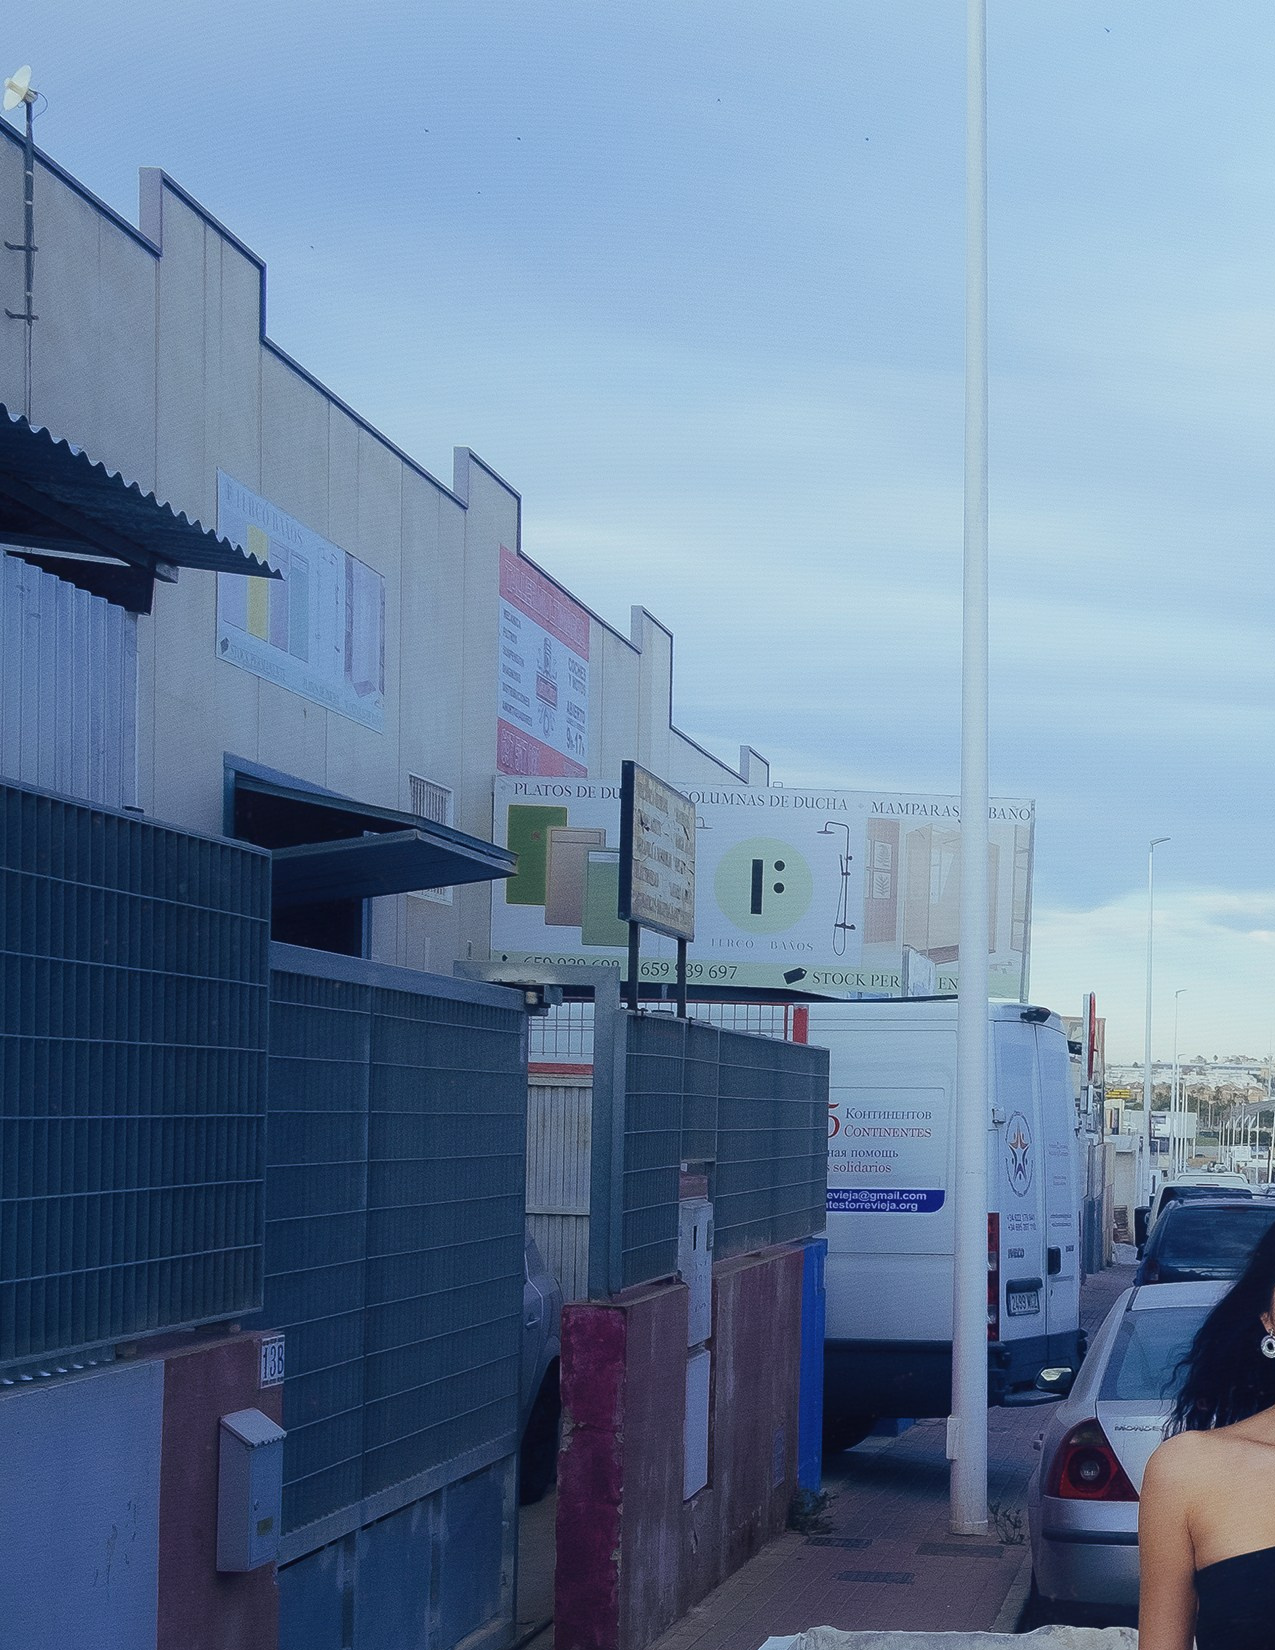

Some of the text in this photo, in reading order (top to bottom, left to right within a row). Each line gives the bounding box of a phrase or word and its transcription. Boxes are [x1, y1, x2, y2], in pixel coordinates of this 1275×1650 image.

[514, 782, 572, 798] PLATOS
[576, 785, 597, 799] DE
[769, 794, 790, 808] DE
[793, 796, 848, 812] DUCHA
[871, 800, 960, 818] MAMPARAS
[988, 804, 1031, 821] BAÑO
[640, 961, 738, 979] 659 39 697
[812, 971, 866, 987] STOCK
[850, 1149, 899, 1159] помощь
[833, 1161, 892, 1174] solidarios
[826, 1190, 927, 1202] evieja@gmail.com
[263, 1344, 284, 1380] 13B
